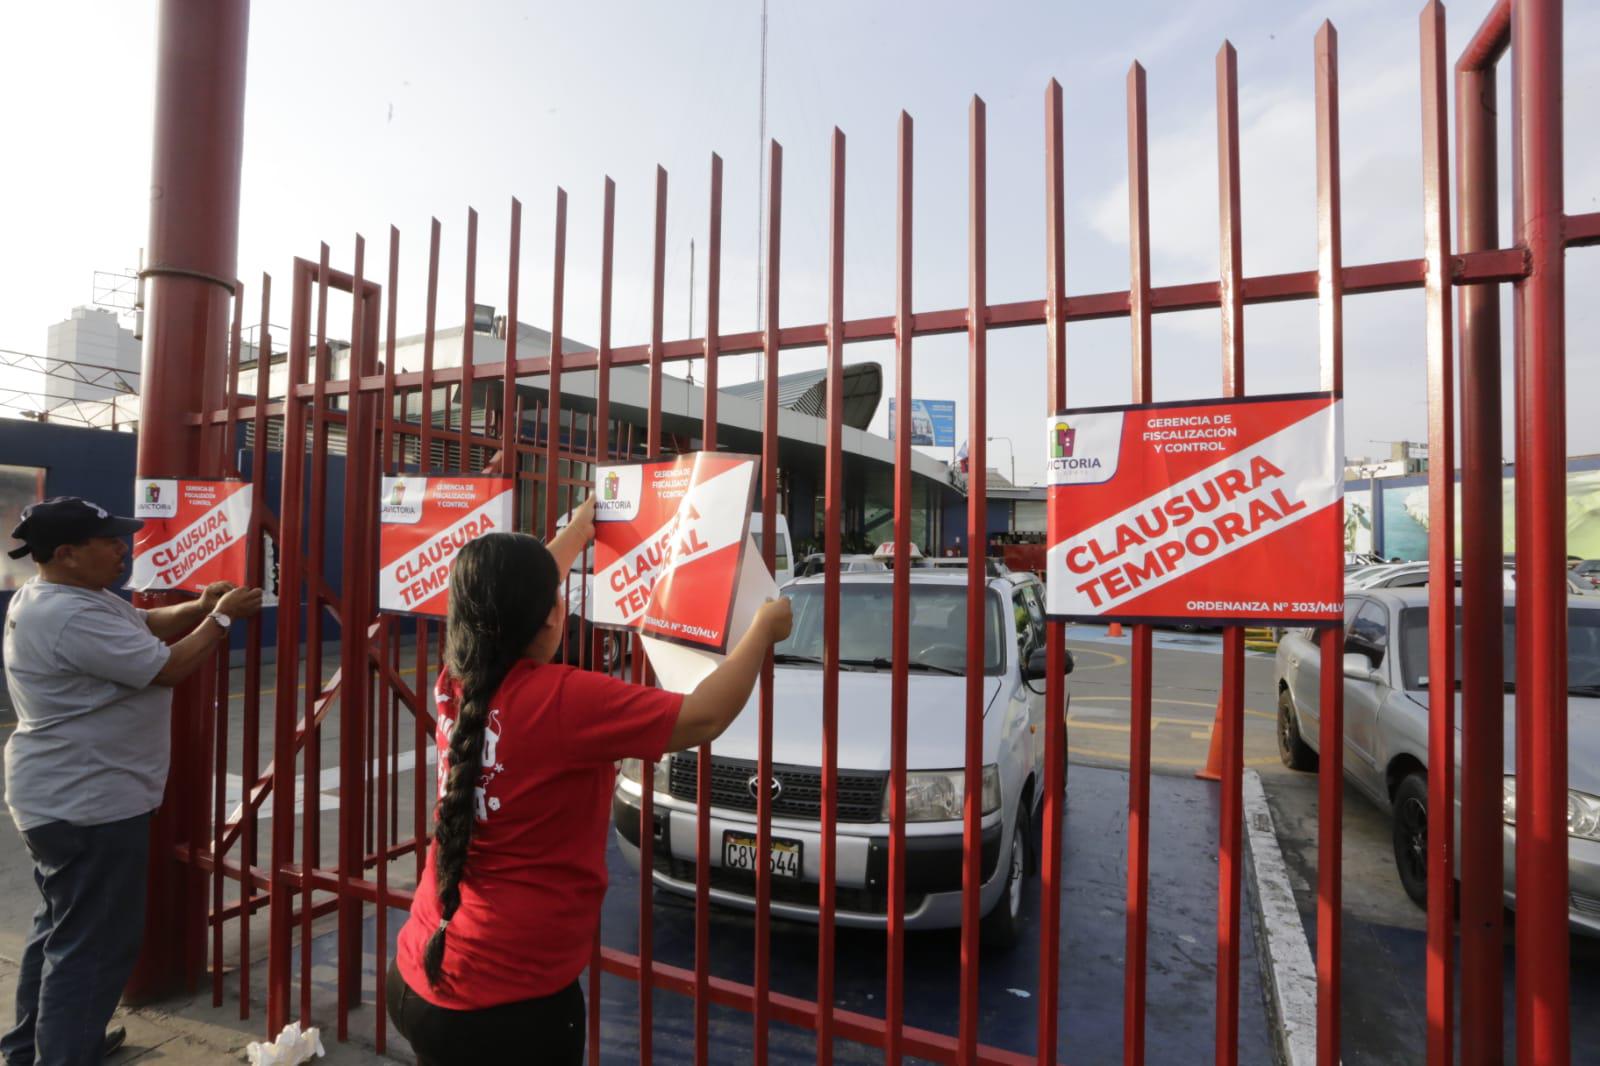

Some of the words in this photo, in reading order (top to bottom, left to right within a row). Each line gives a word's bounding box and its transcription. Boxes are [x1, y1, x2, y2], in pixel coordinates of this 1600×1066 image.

[1143, 426, 1237, 441] FISCALIZACIÓN
[1147, 415, 1210, 428] GERENCIA
[1213, 414, 1232, 425] DE
[1154, 444, 1162, 453] Y
[1165, 441, 1226, 453] CONTROL
[151, 510, 228, 567] CLAUSURA
[1065, 455, 1285, 574] CLAUSURA
[157, 528, 233, 585] TEMPORAL
[395, 513, 495, 583] CLAUSURA
[1076, 488, 1306, 608] TEMPORAL
[400, 559, 456, 606] TEMP
[1186, 600, 1269, 612] ORDENANZA
